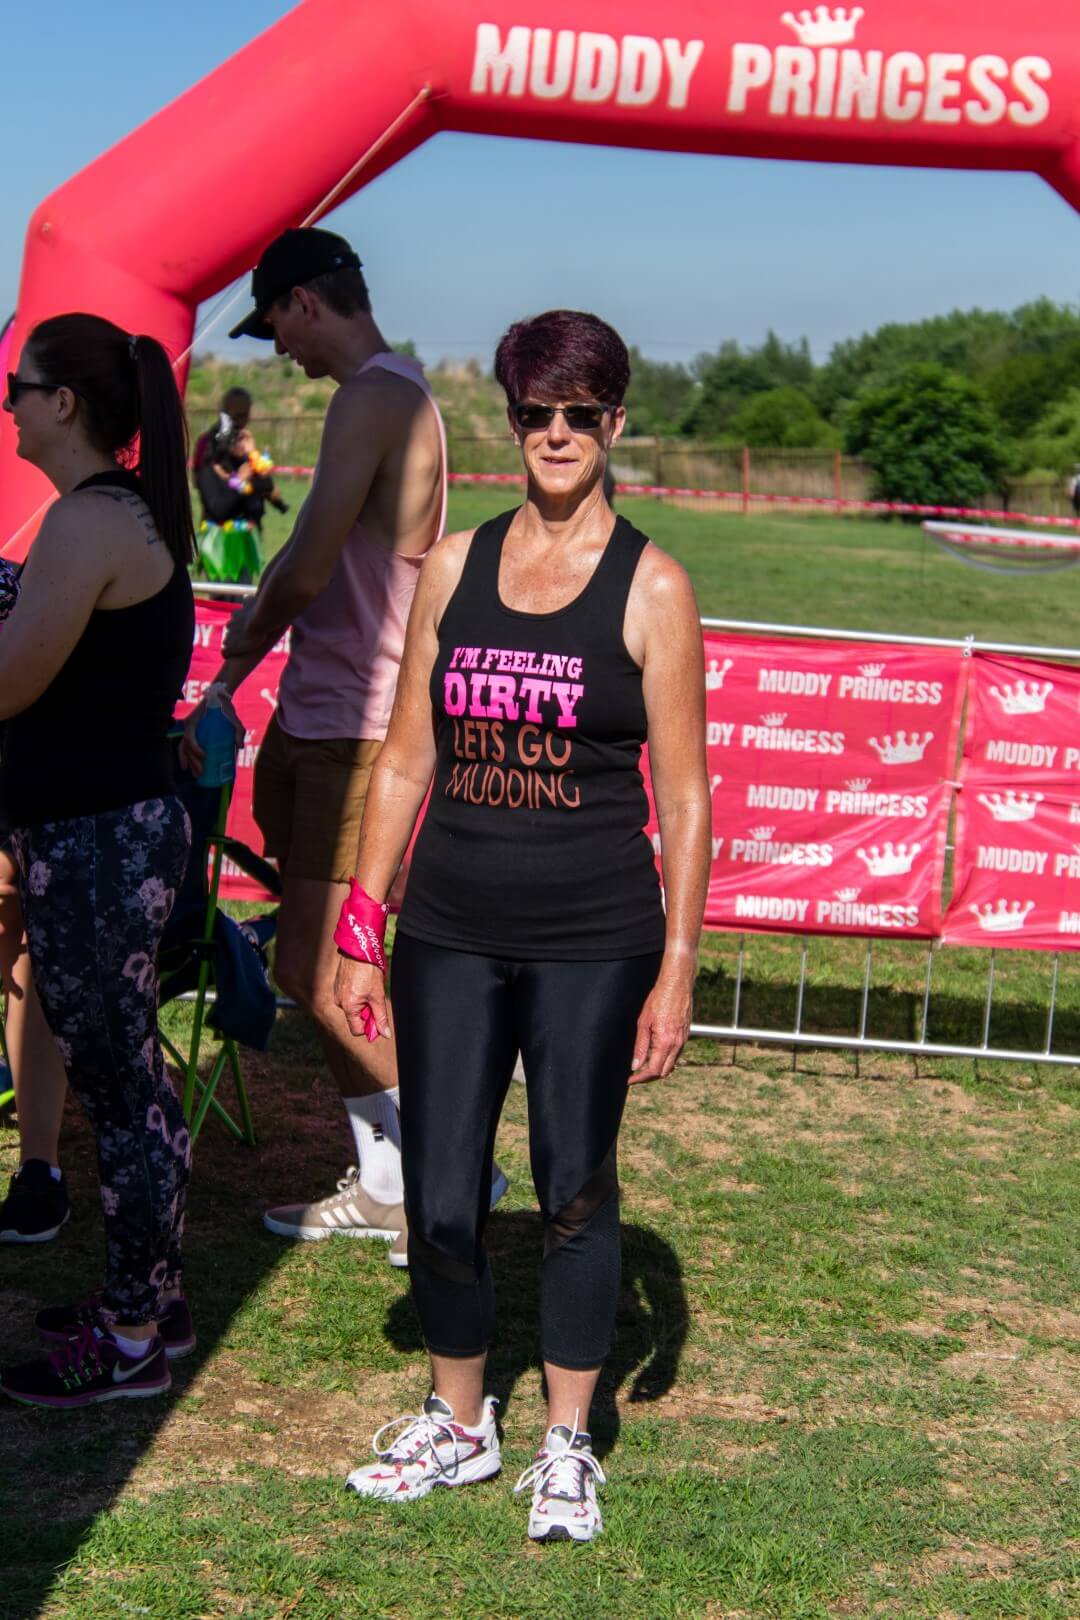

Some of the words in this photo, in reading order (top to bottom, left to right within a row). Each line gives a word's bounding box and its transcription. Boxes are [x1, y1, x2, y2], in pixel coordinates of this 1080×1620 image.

[470, 23, 704, 108] MUDDY
[726, 43, 1052, 125] PRINCESS
[449, 647, 481, 669] I'M
[481, 648, 583, 680] FEELING
[443, 672, 584, 727] DIRTY
[758, 669, 831, 697] MUDDY
[839, 675, 943, 705] PRINCESS
[453, 719, 506, 762] LETS
[517, 724, 572, 766] GO
[741, 725, 845, 755] PRINCESS
[986, 740, 1058, 768] MUDDY
[445, 762, 581, 808] MUDDING
[747, 785, 819, 812] MUDDY
[826, 790, 928, 819] PRINCESS
[730, 838, 833, 867] PRINCESS
[977, 846, 1048, 875] MUDDY
[736, 895, 809, 921] MUDDY
[817, 899, 919, 928] PRINCESS
